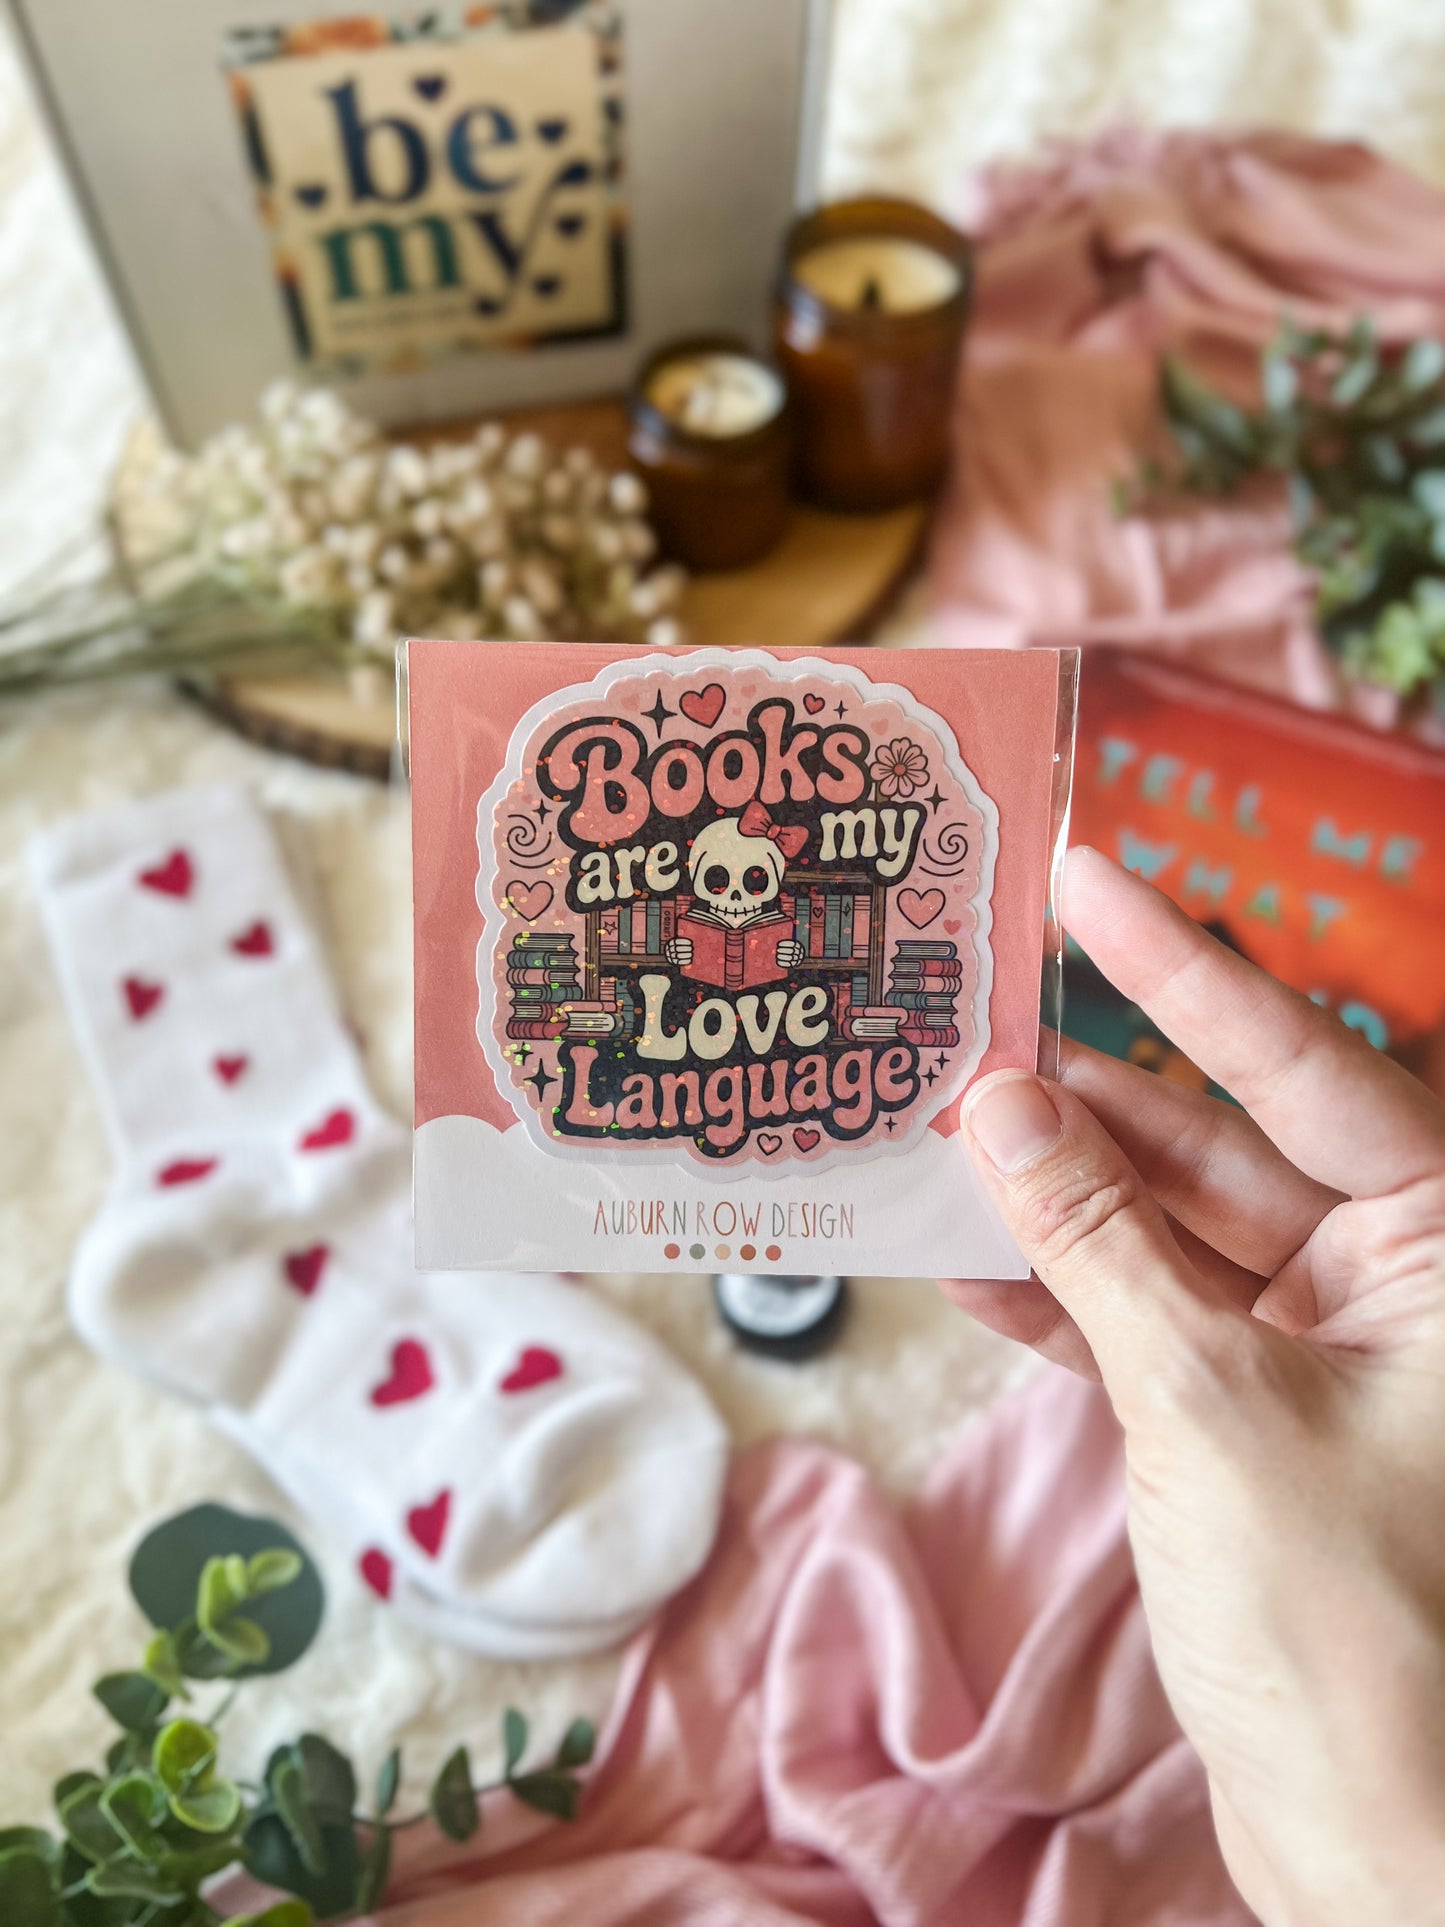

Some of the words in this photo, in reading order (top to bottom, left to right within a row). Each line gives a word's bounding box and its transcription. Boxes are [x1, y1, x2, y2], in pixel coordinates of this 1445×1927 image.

[324, 73, 521, 206] be
[316, 161, 592, 318] my
[547, 704, 867, 843] Books
[1097, 736, 1268, 838] TELL
[1310, 815, 1425, 887] ME
[576, 841, 681, 903] are
[819, 807, 920, 878] my
[1117, 827, 1348, 943] WHAT
[636, 974, 829, 1061] Love
[564, 1045, 915, 1148] Language
[593, 1200, 687, 1236] AUBURN
[696, 1200, 762, 1237] ROW
[771, 1202, 854, 1239] DESIGN
